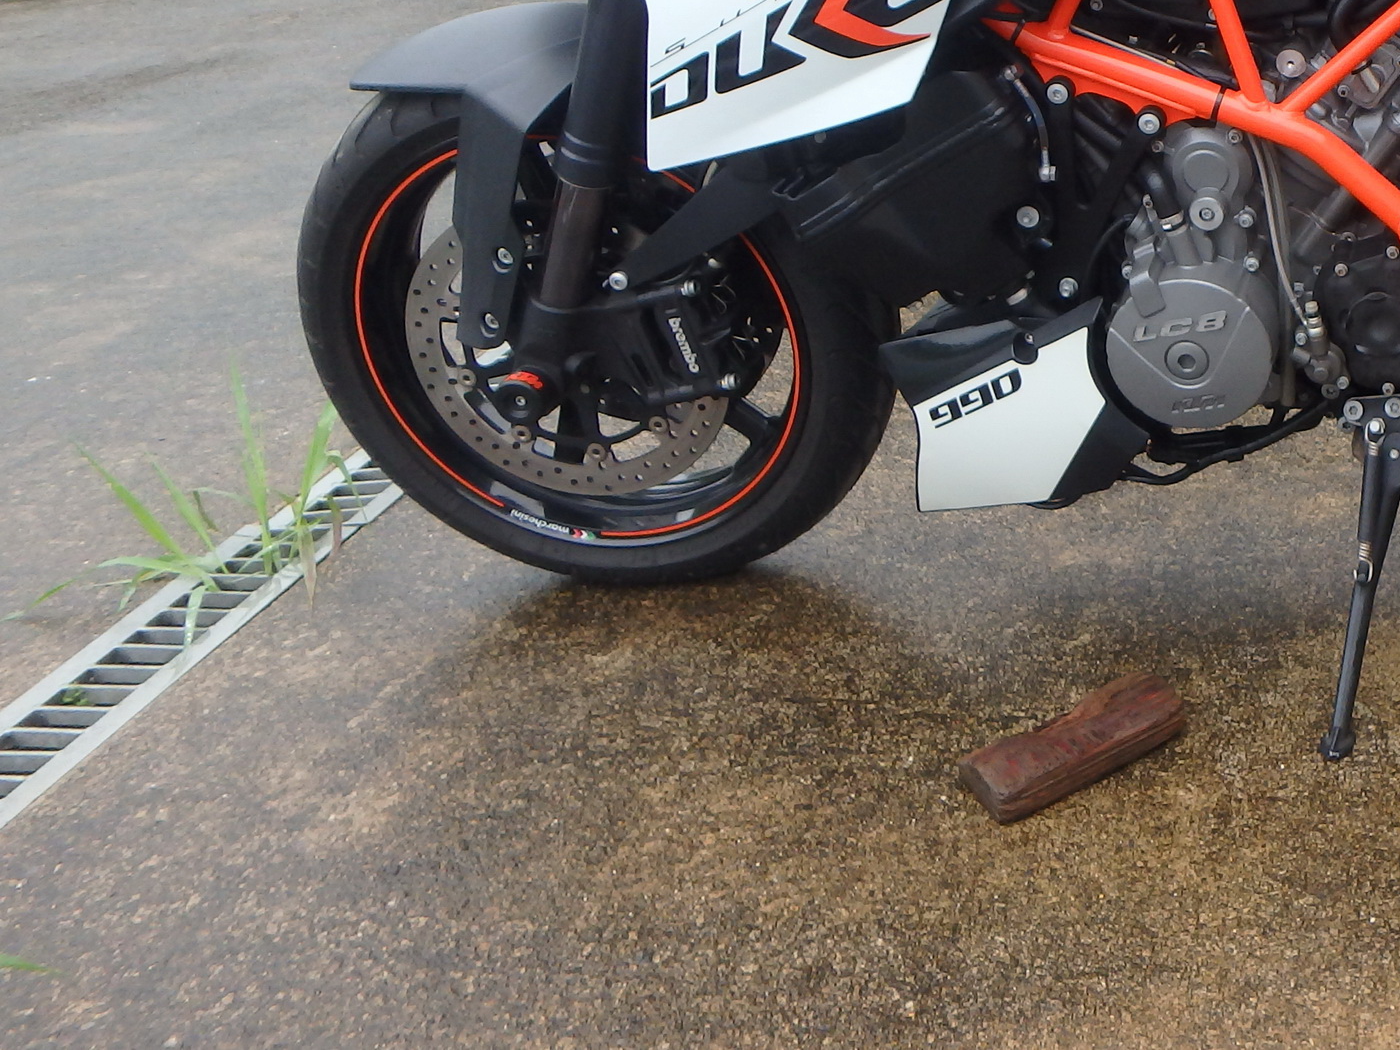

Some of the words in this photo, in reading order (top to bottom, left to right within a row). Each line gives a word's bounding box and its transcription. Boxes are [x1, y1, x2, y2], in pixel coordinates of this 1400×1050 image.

[668, 317, 700, 373] brembo
[1133, 310, 1227, 342] LC8
[929, 367, 1022, 429] 990
[510, 509, 570, 535] marchesini
